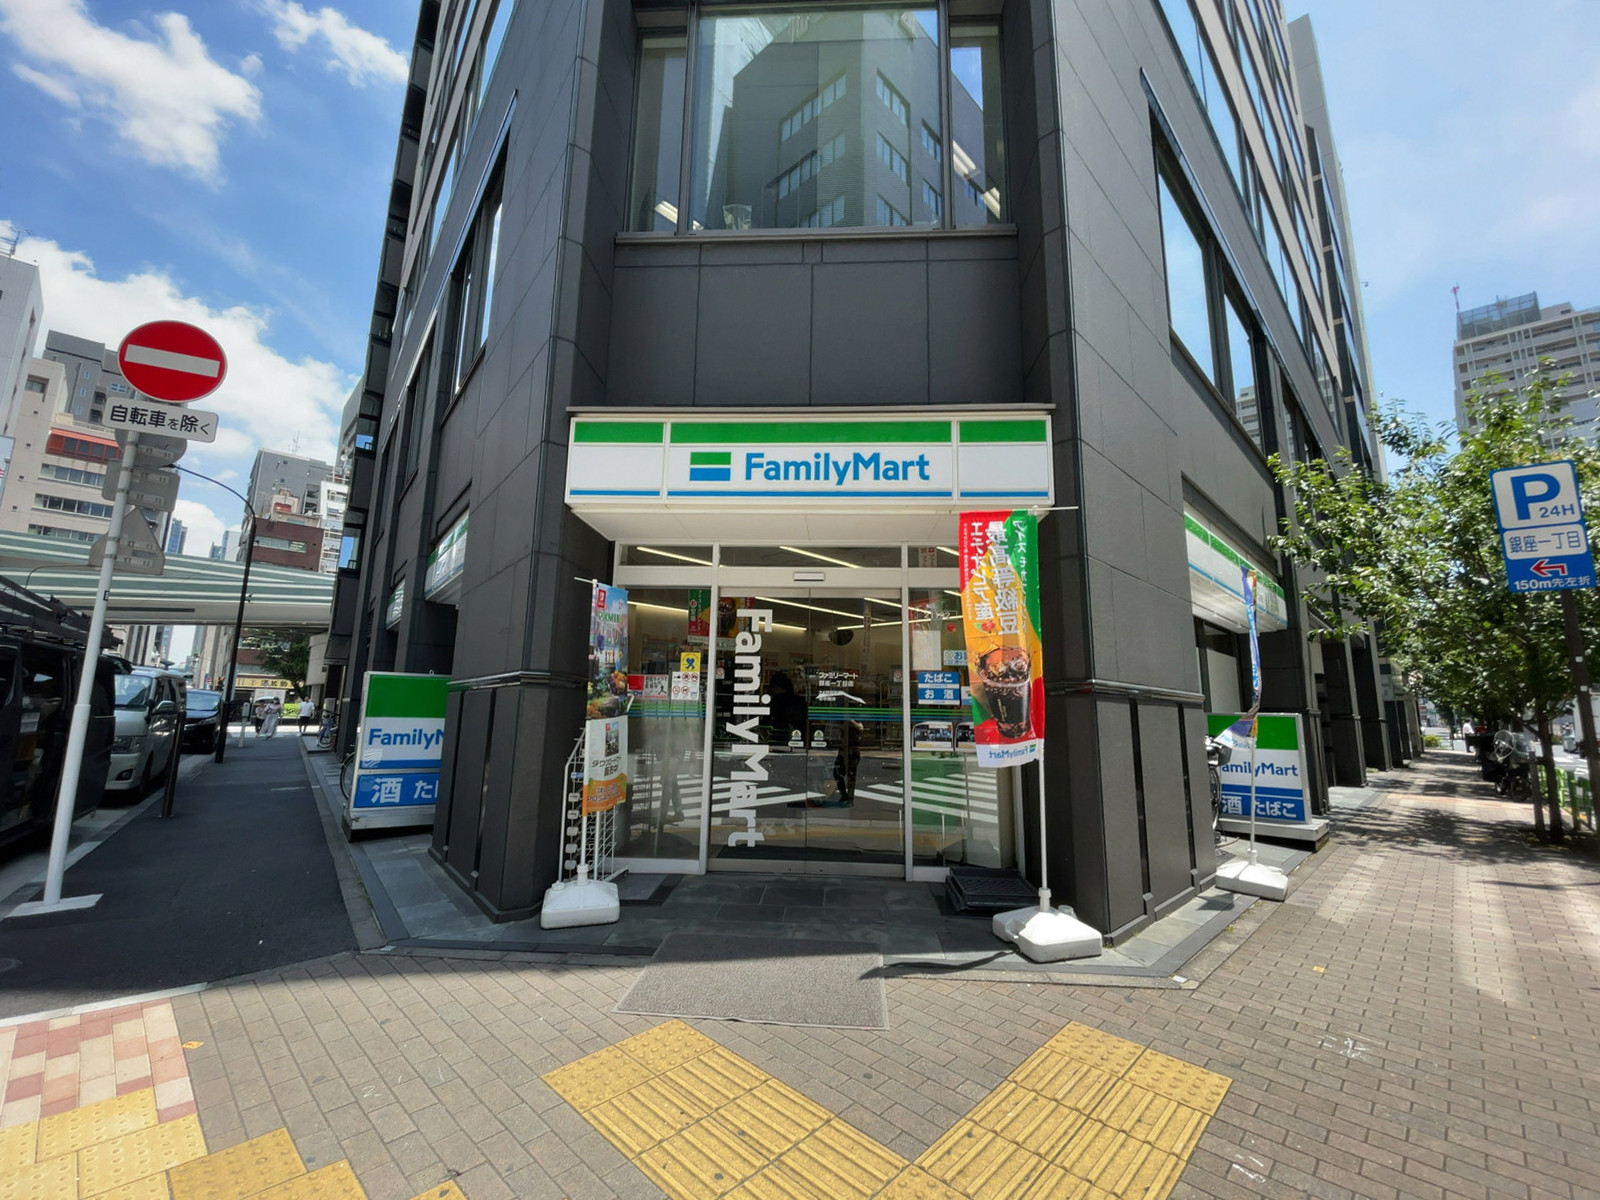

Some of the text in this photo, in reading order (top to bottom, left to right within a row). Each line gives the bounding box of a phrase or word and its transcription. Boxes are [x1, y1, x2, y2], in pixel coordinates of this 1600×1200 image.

[110, 405, 210, 435] 自転車を除く
[745, 452, 930, 486] FamilyMart
[1510, 473, 1561, 521] P
[1539, 503, 1576, 518] 24H
[1508, 531, 1582, 554] 銀座一丁目
[1514, 575, 1591, 591] 150m先左折
[818, 671, 859, 680] ファミリーマート
[924, 673, 953, 683] たばこ
[726, 608, 773, 848] FamilyMart
[1221, 761, 1298, 777] amilyMart
[371, 777, 403, 804] 酒
[1221, 795, 1243, 815] 酒
